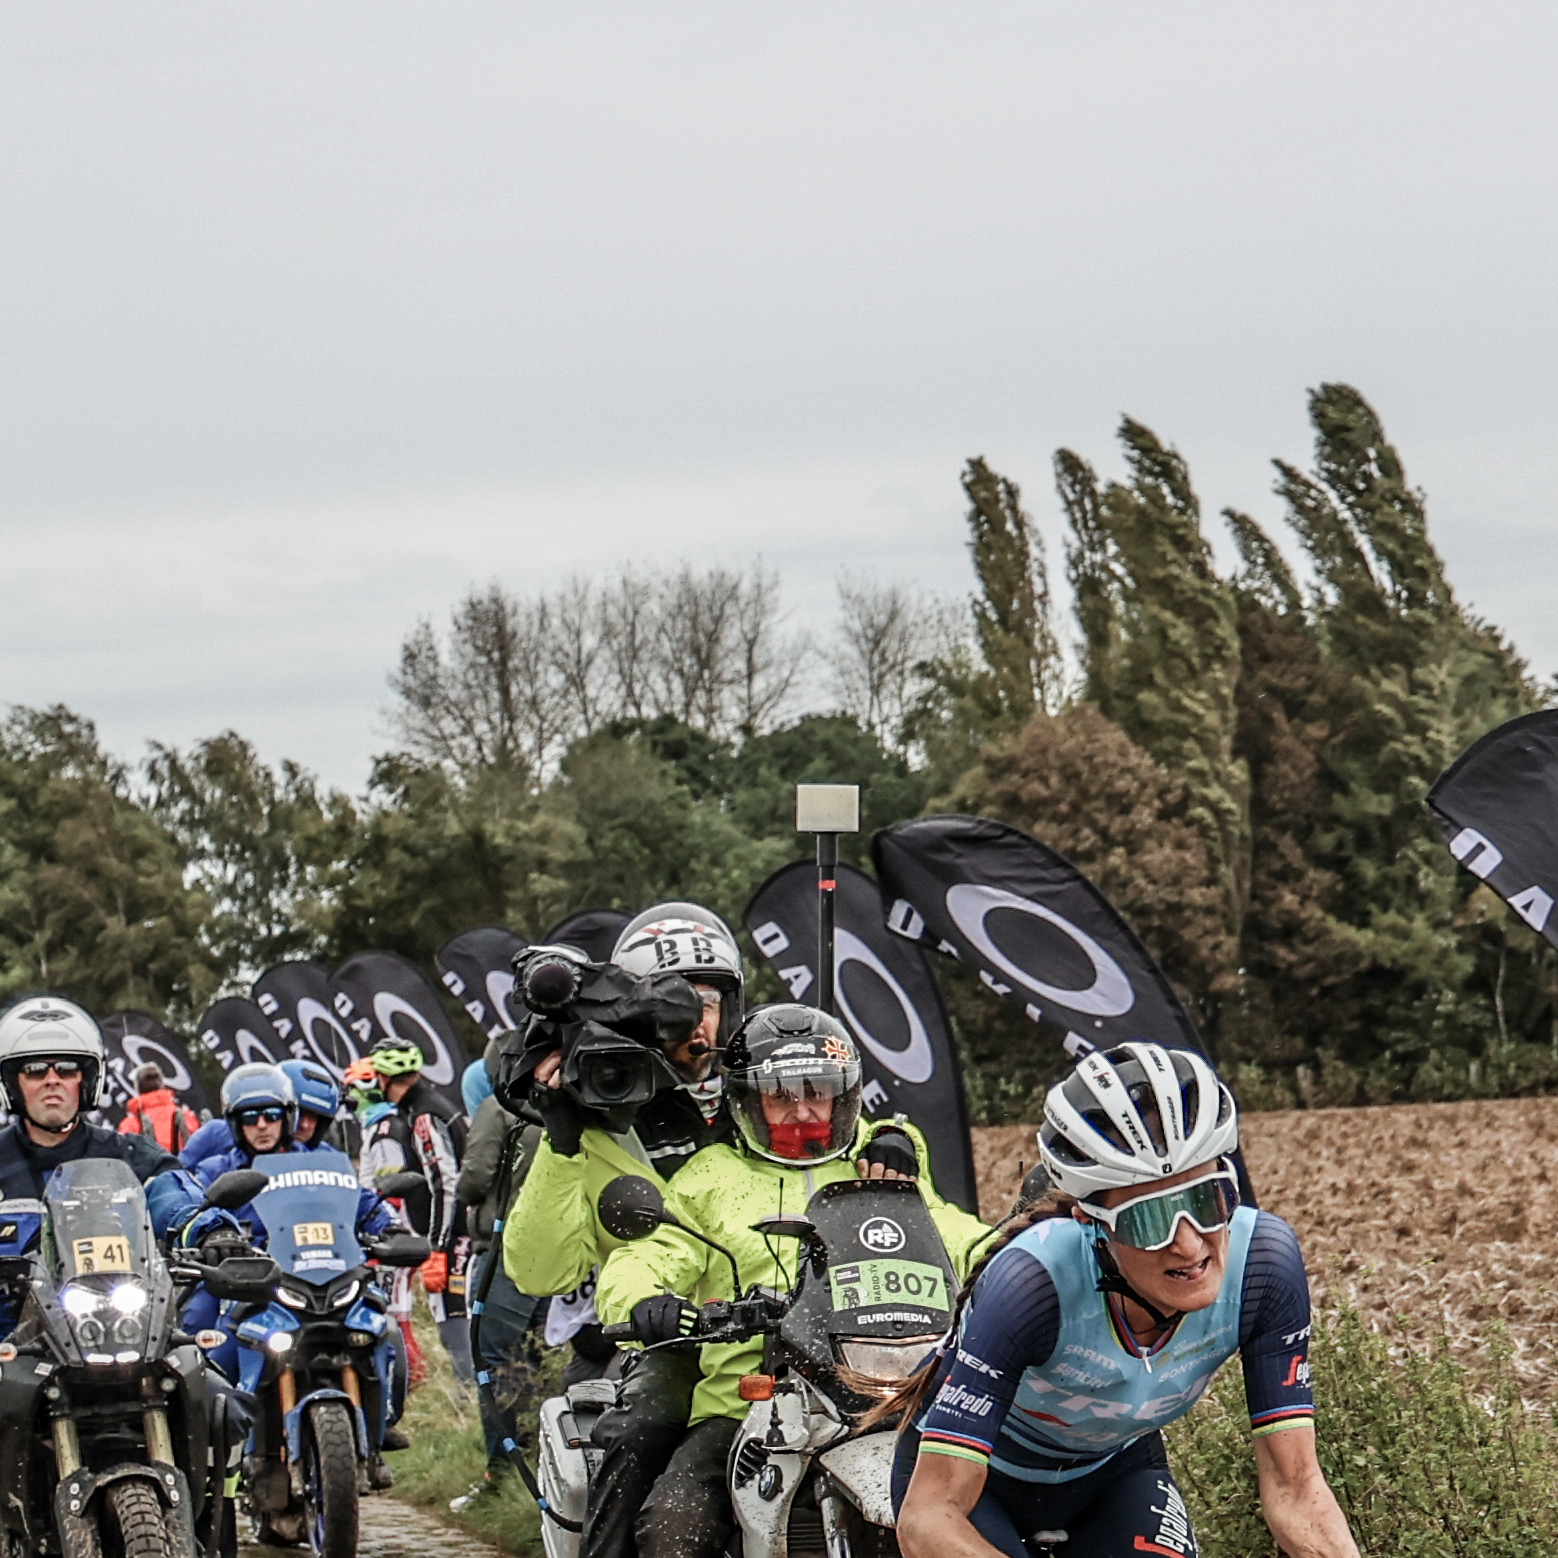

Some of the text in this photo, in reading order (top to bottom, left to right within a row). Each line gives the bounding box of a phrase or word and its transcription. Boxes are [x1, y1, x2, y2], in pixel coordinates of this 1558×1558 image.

[1121, 1110, 1149, 1151] TREK
[103, 1244, 126, 1263] 41
[884, 1271, 939, 1299] 807
[857, 1312, 932, 1325] EUROMEDIA
